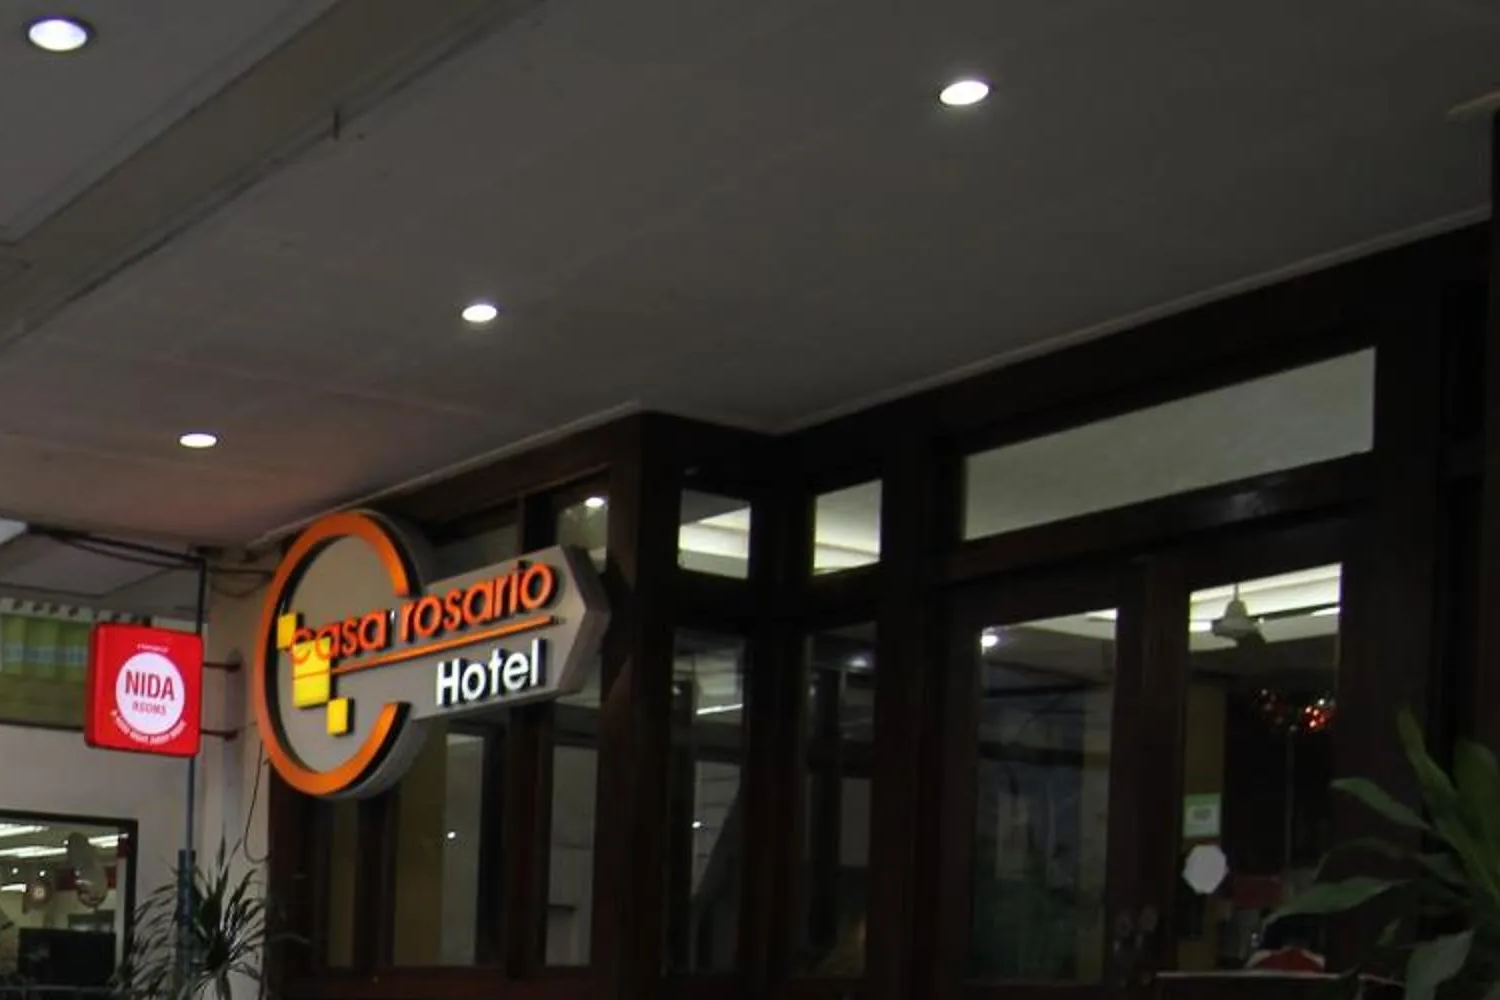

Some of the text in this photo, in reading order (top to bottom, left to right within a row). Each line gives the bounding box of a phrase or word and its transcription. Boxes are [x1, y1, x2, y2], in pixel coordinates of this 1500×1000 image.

[290, 561, 553, 664] casa rosario
[124, 669, 175, 701] NIDA
[435, 637, 539, 706] Hotel
